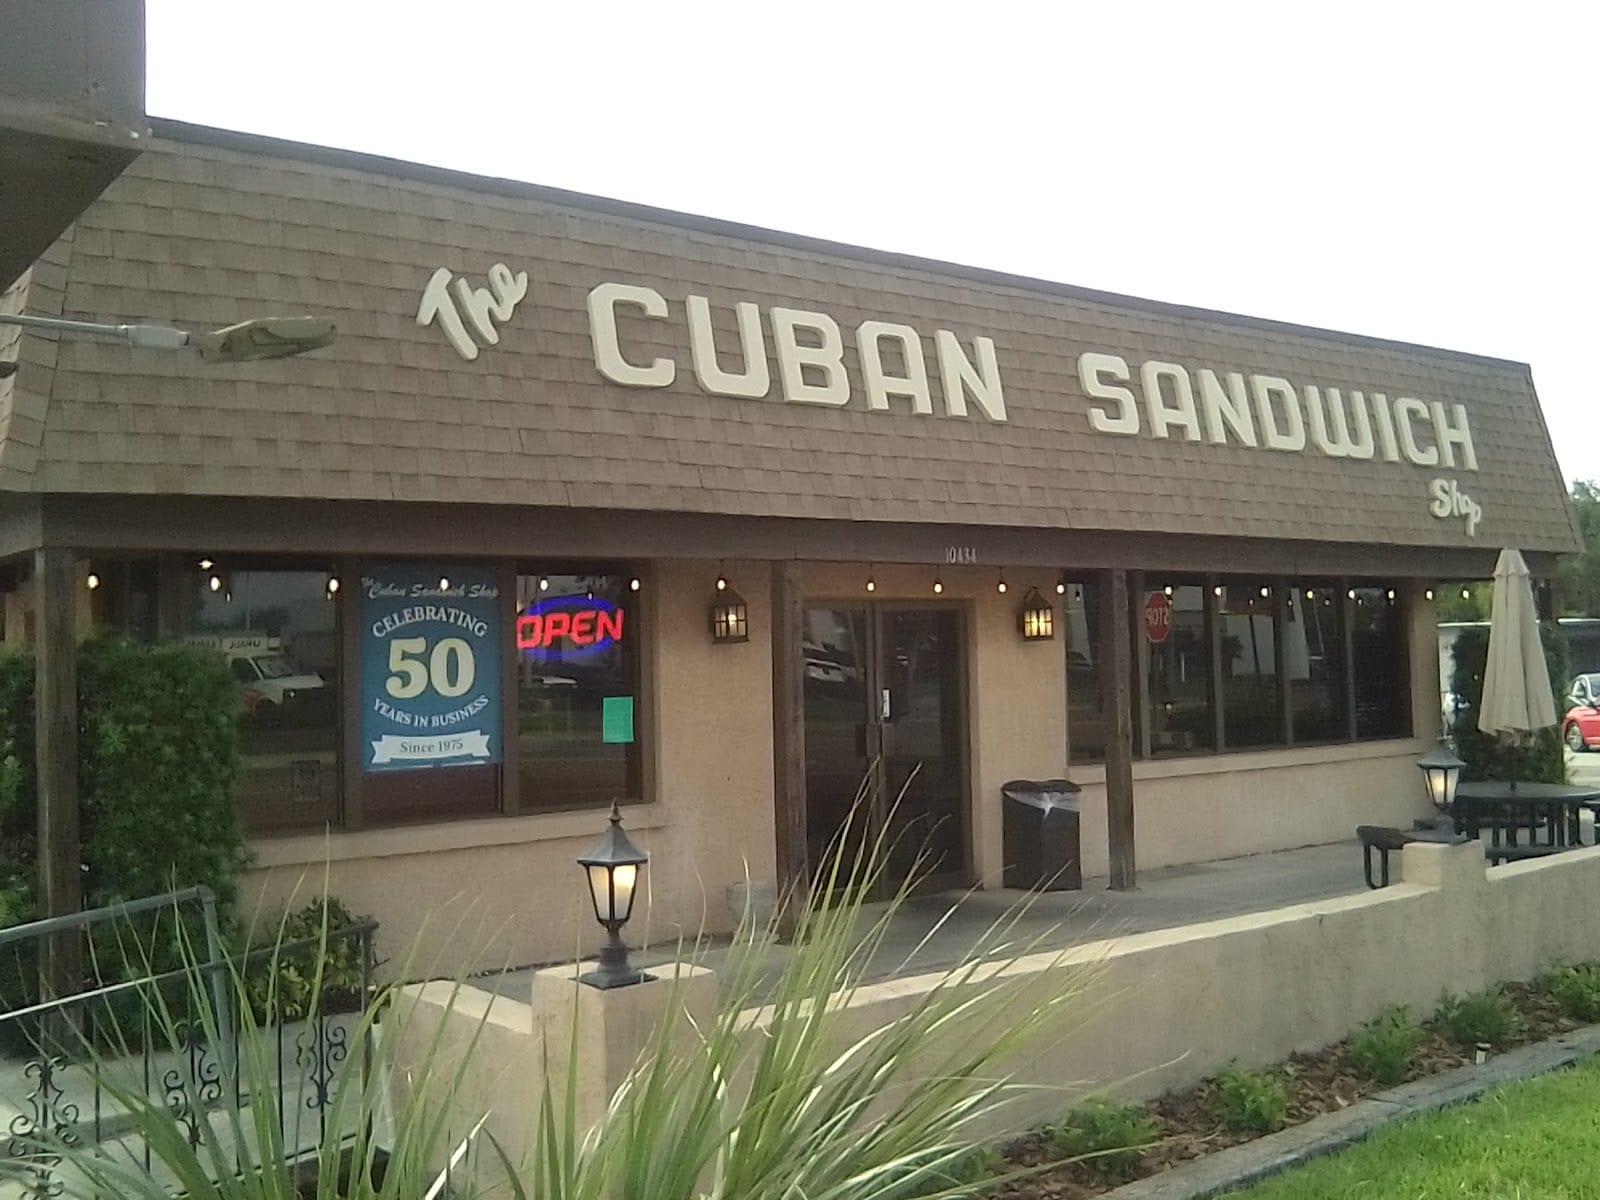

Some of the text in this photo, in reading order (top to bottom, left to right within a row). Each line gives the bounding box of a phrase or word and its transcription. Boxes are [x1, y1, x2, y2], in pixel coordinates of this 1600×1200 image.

[416, 262, 1479, 470] The CUBAN SANDWICH
[1429, 478, 1482, 537] Shop
[945, 546, 977, 564] 10434
[372, 605, 488, 637] CELEBRATING
[516, 609, 624, 649] OPEN
[385, 637, 475, 699] 50
[373, 694, 489, 728] YEARS IN BUSINESS
[400, 739, 464, 753] Since 1975
